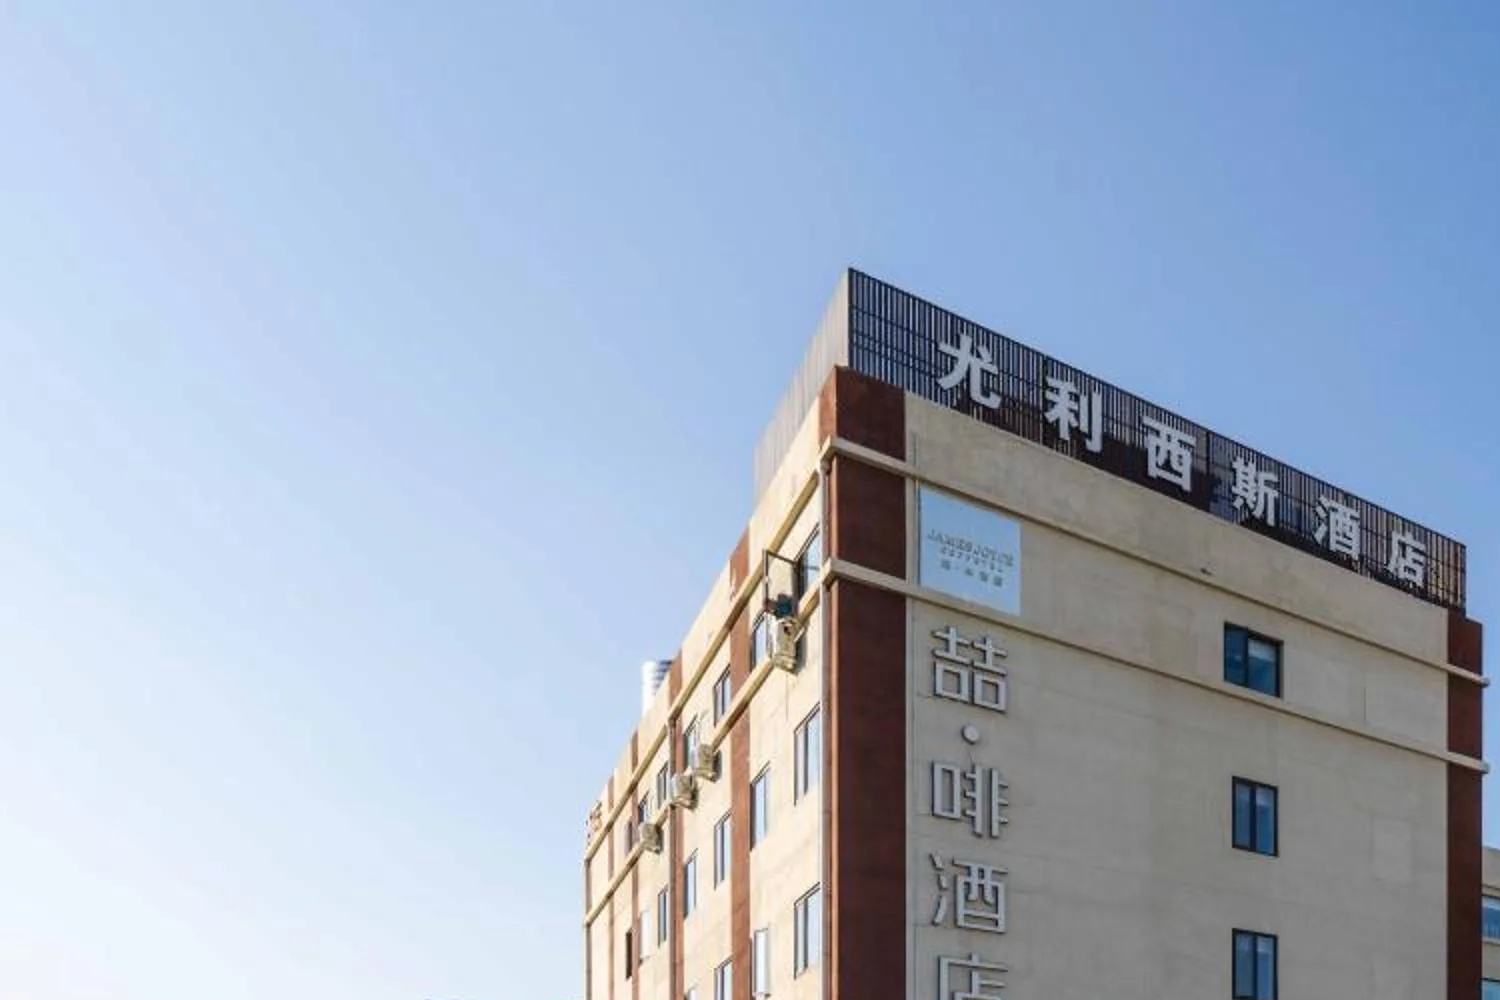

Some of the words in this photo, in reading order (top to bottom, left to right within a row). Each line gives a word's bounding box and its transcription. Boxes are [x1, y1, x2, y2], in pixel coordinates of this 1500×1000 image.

[937, 333, 1427, 588] 尤利西斯酒店
